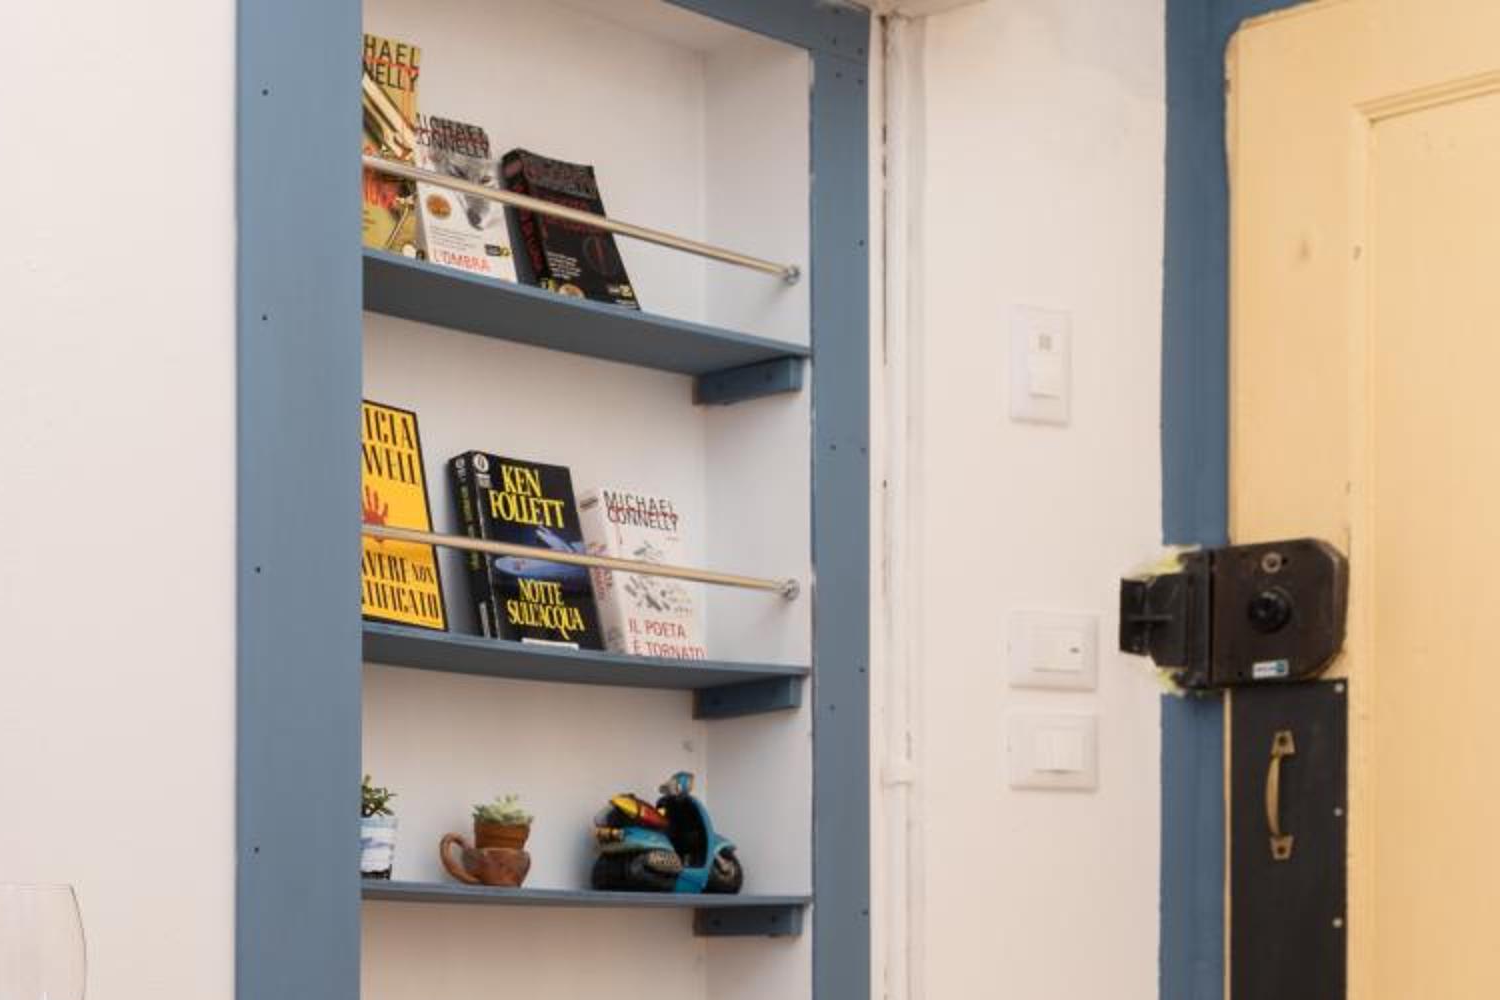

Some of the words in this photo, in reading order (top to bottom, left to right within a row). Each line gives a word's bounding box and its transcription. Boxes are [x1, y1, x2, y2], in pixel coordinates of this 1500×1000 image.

[363, 34, 420, 68] HAEL
[363, 62, 419, 92] NELLY
[364, 408, 414, 450] ICIA
[362, 443, 417, 485] WELL
[501, 464, 542, 497] KEN
[489, 490, 564, 529] FOLLETT
[603, 490, 673, 514] MICHAEL
[608, 506, 679, 532] CONNELLY
[366, 579, 439, 619] TIFICATO
[518, 578, 565, 606] NOTTE
[507, 599, 585, 641] SULL'ACQUA
[628, 619, 642, 634] IL
[644, 620, 686, 638] POETA
